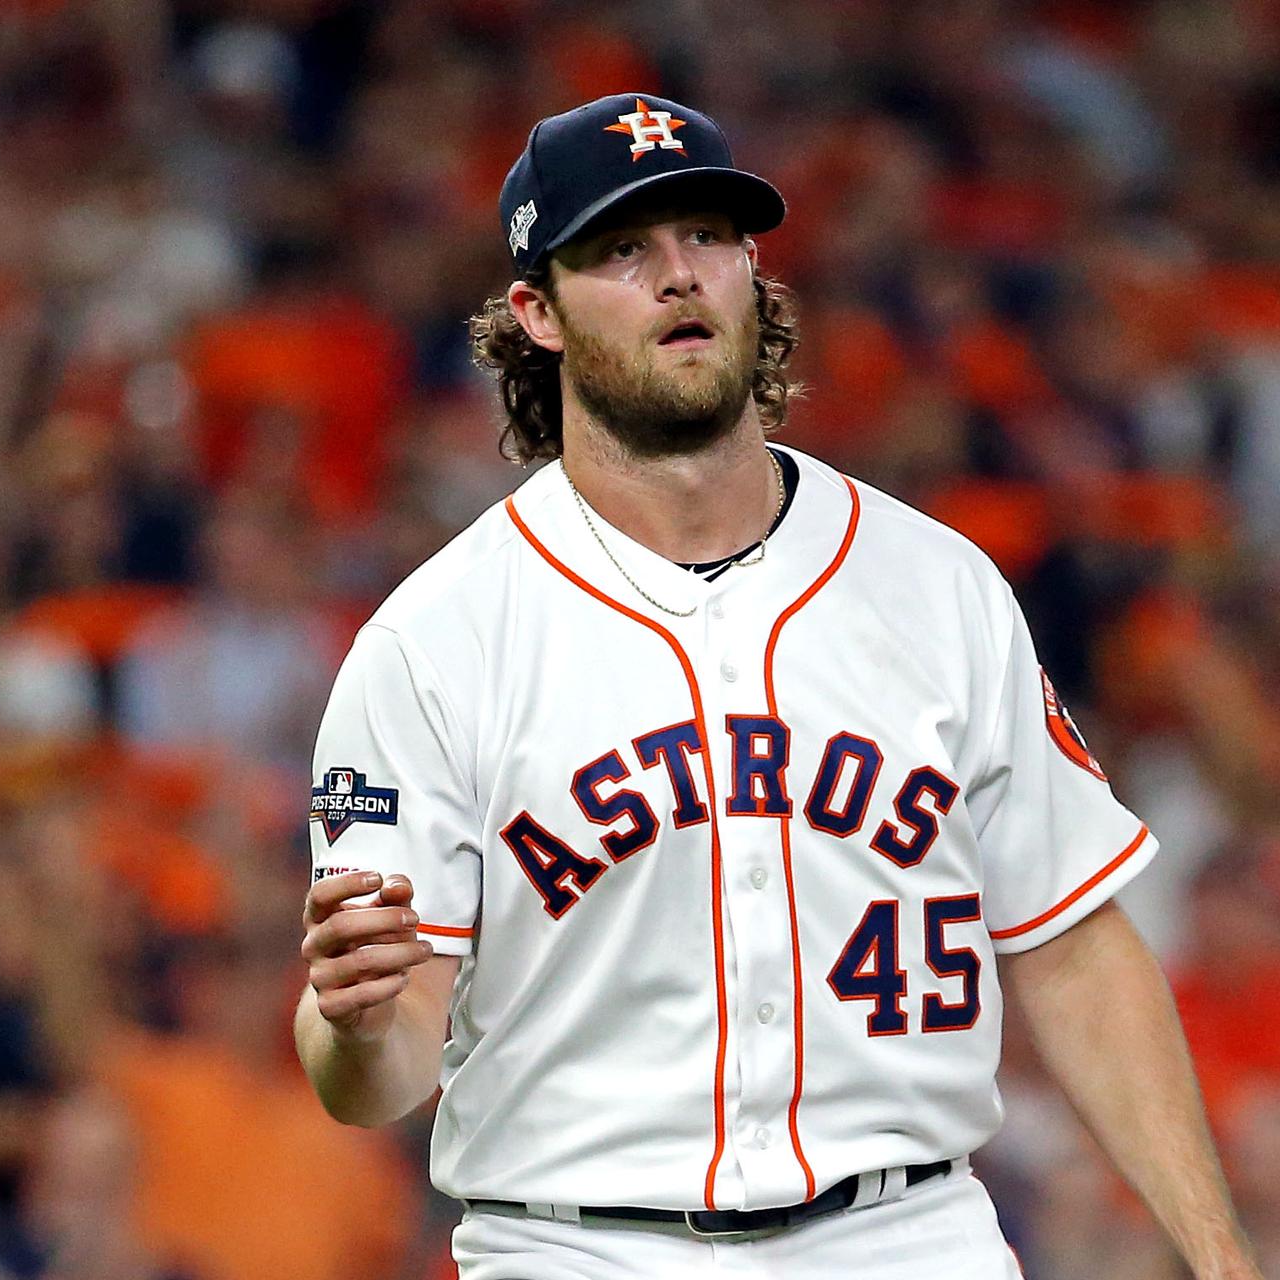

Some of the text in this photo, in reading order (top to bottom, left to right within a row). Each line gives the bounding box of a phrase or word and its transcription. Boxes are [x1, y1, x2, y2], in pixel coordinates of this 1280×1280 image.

[617, 110, 683, 153] H
[312, 795, 390, 814] POSTSEASON
[327, 811, 346, 820] 2019
[499, 713, 960, 920] ASTROS
[826, 892, 983, 1038] 45
